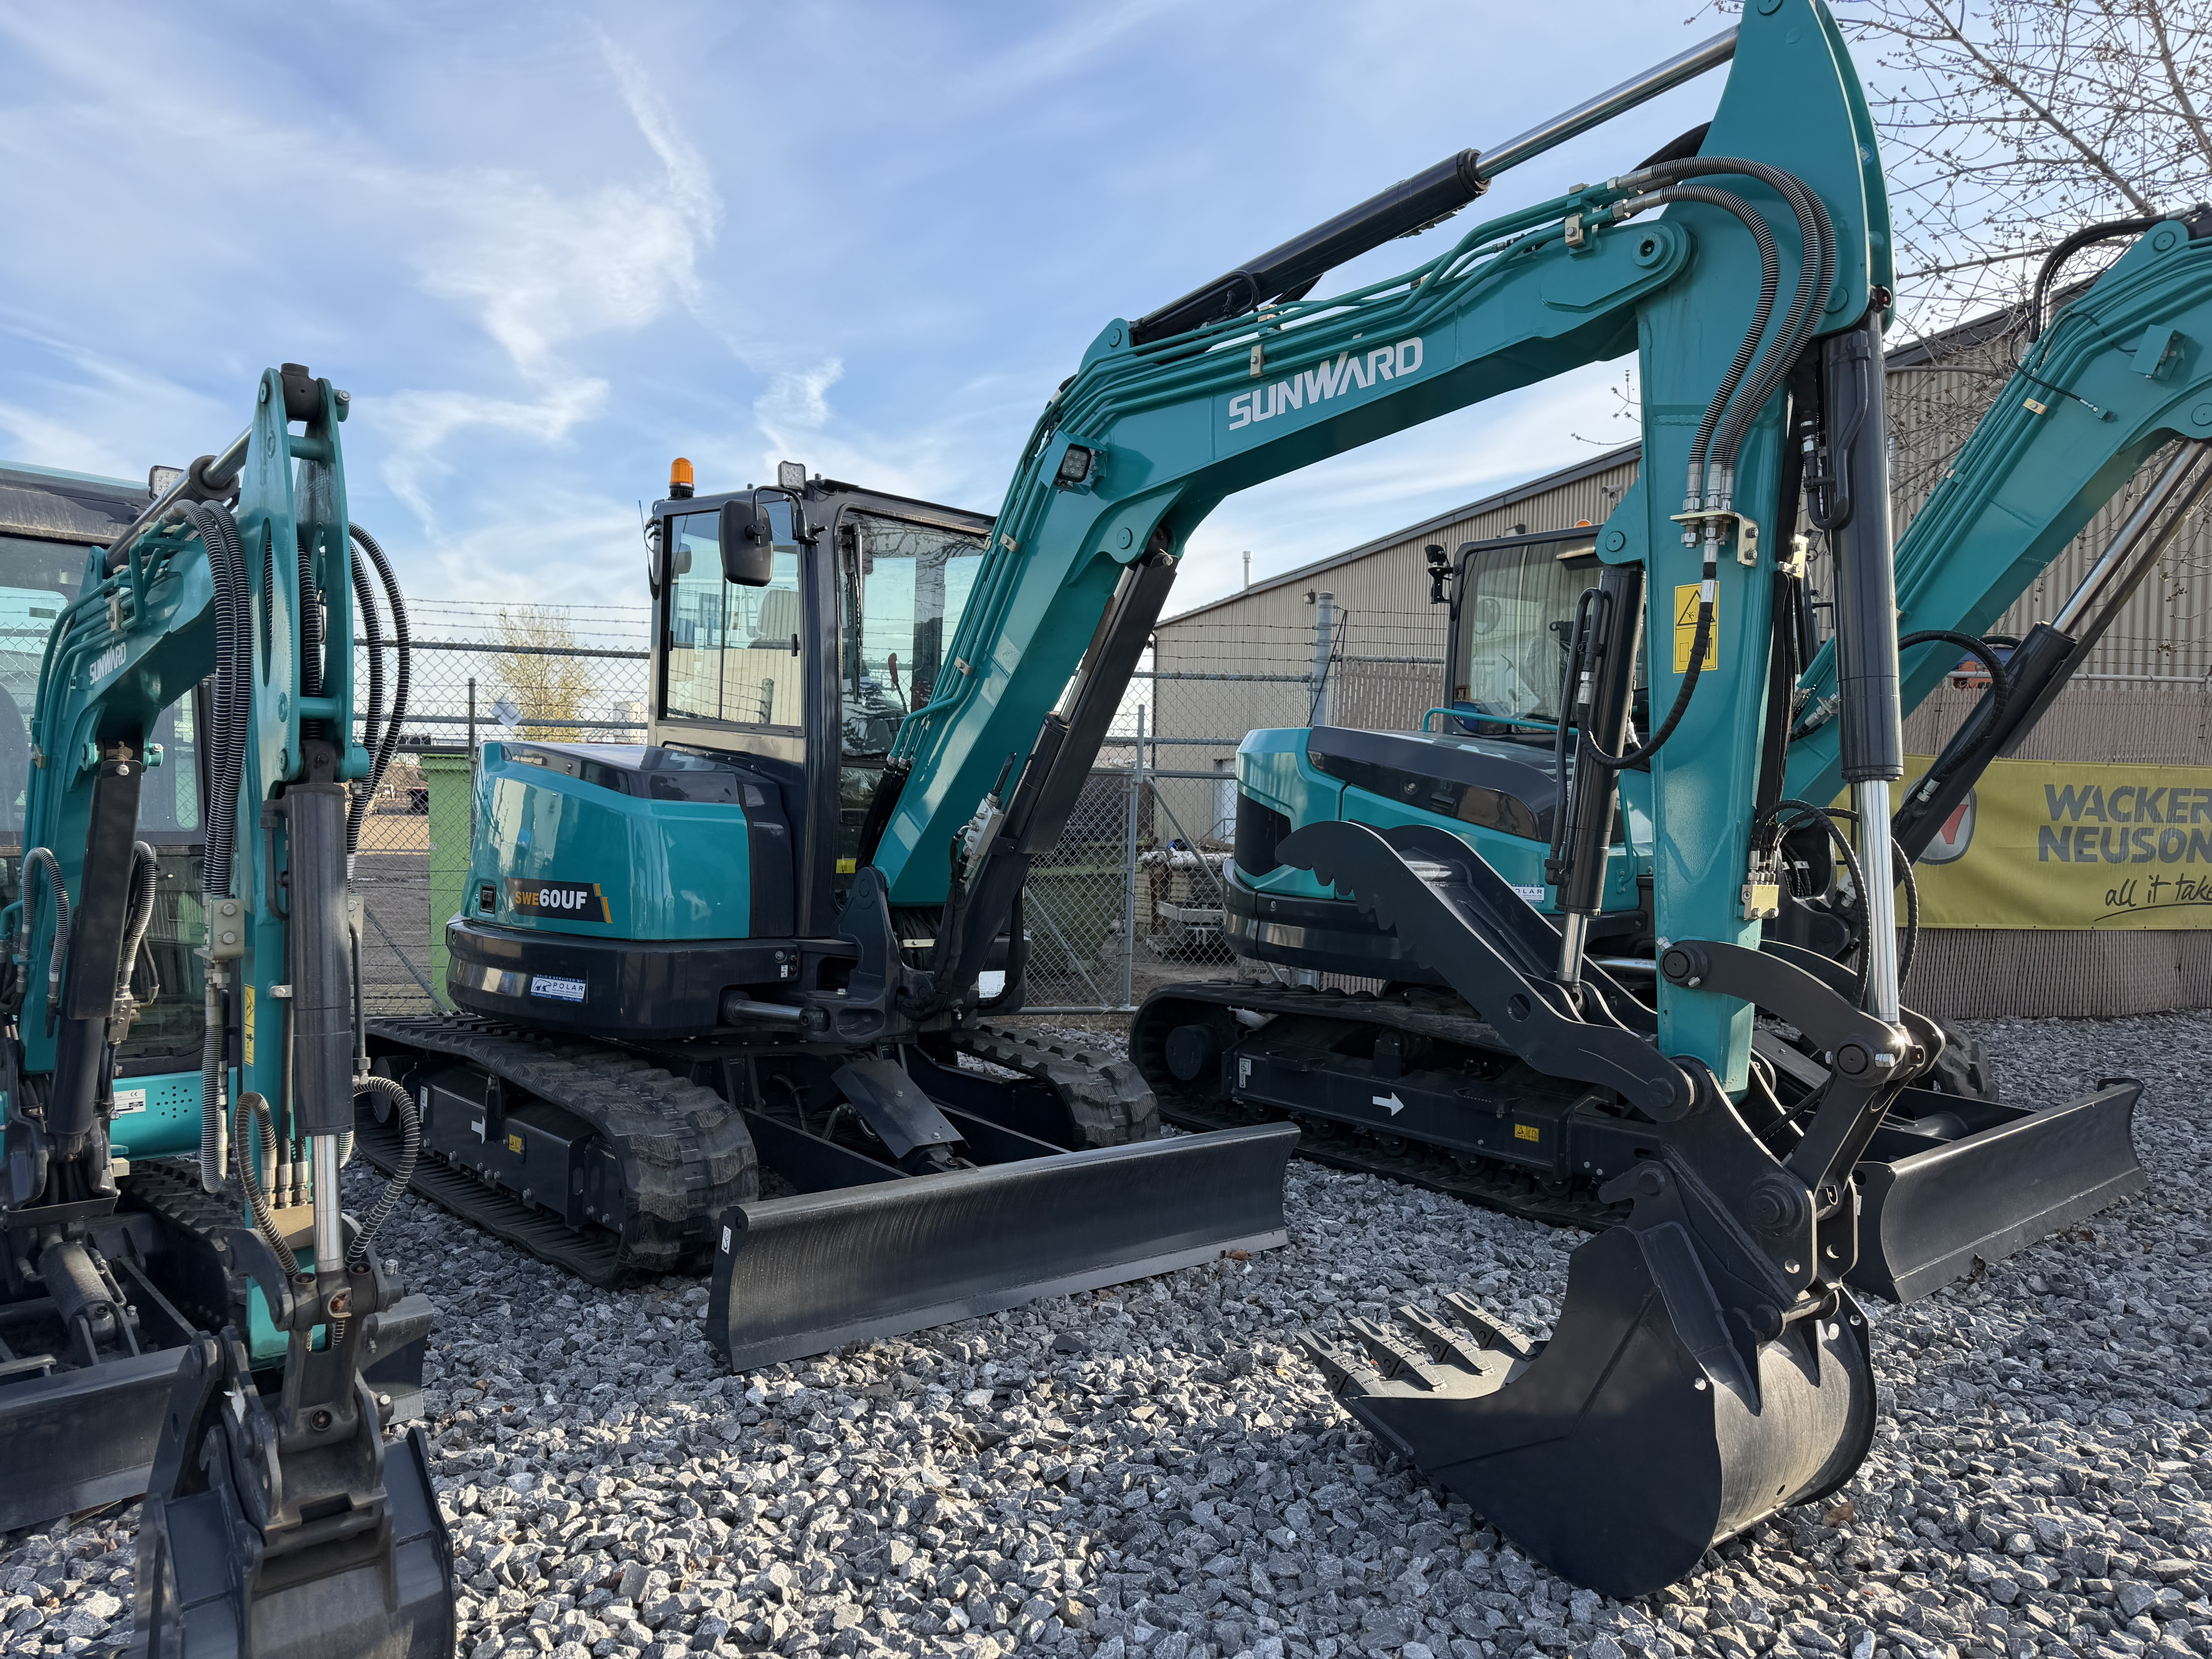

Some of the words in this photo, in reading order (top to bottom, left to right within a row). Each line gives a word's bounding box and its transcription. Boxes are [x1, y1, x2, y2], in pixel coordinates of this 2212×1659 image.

[1229, 336, 1424, 431] SUNWARD
[89, 641, 126, 685] SUNWARD
[2044, 784, 2212, 824] WACKER
[2038, 825, 2212, 864] NEUSON
[515, 888, 587, 910] SWE60UF
[2105, 878, 2137, 907] all
[2148, 874, 2172, 903] it
[553, 982, 584, 991] POLAR
